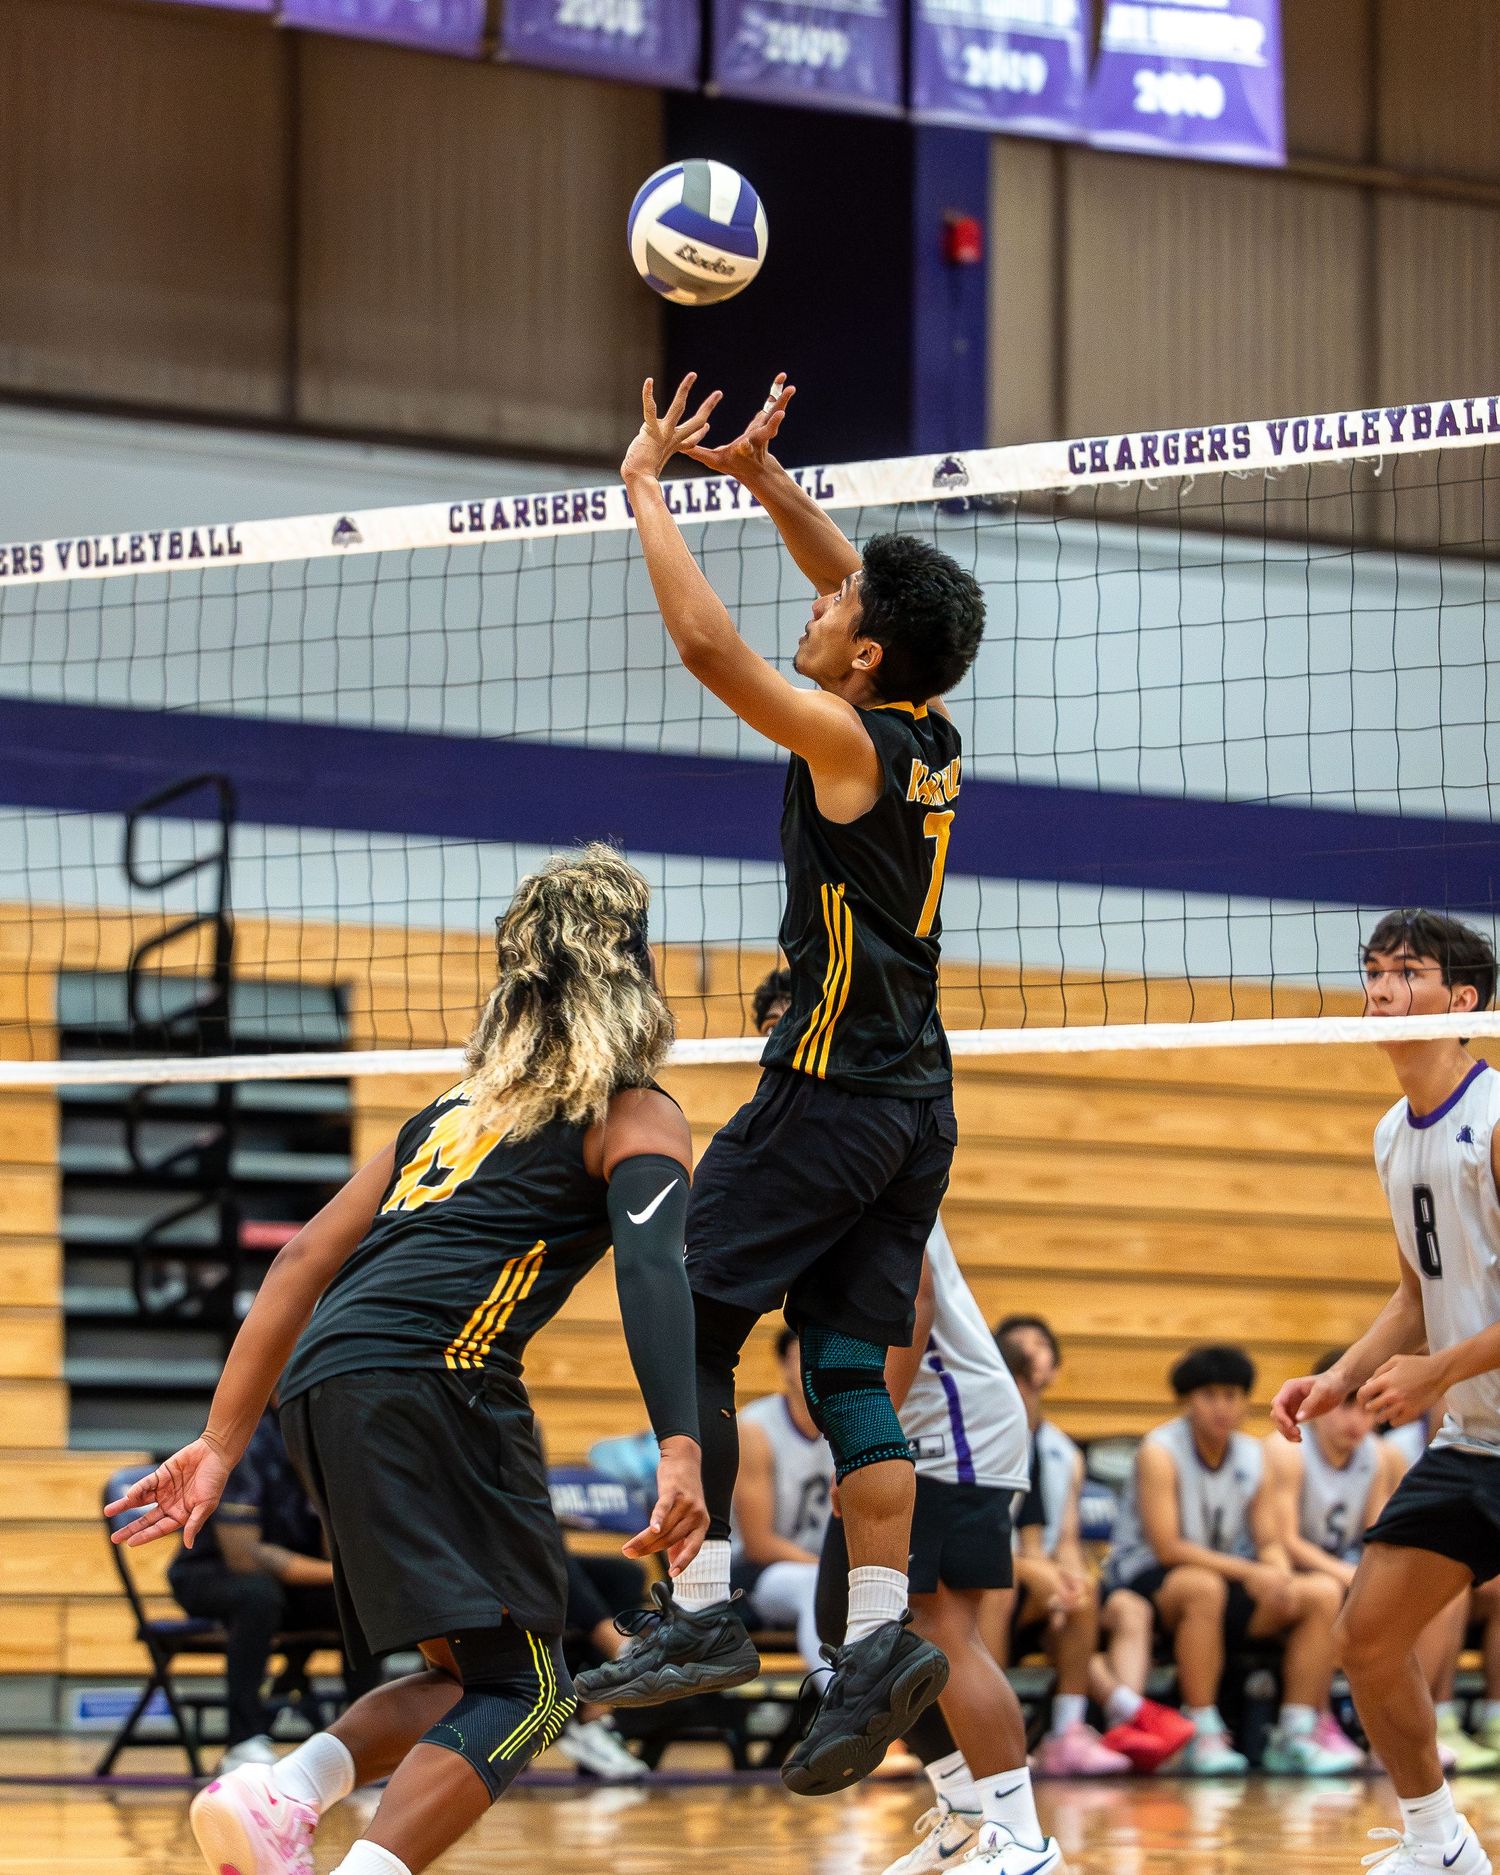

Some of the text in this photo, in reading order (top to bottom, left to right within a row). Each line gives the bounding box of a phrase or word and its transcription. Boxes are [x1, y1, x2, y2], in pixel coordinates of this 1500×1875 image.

[1067, 424, 1252, 475] CHARGERS
[449, 490, 607, 534] CHARGERS
[57, 526, 243, 570] VOLLEYBALL
[1412, 1183, 1443, 1279] 8
